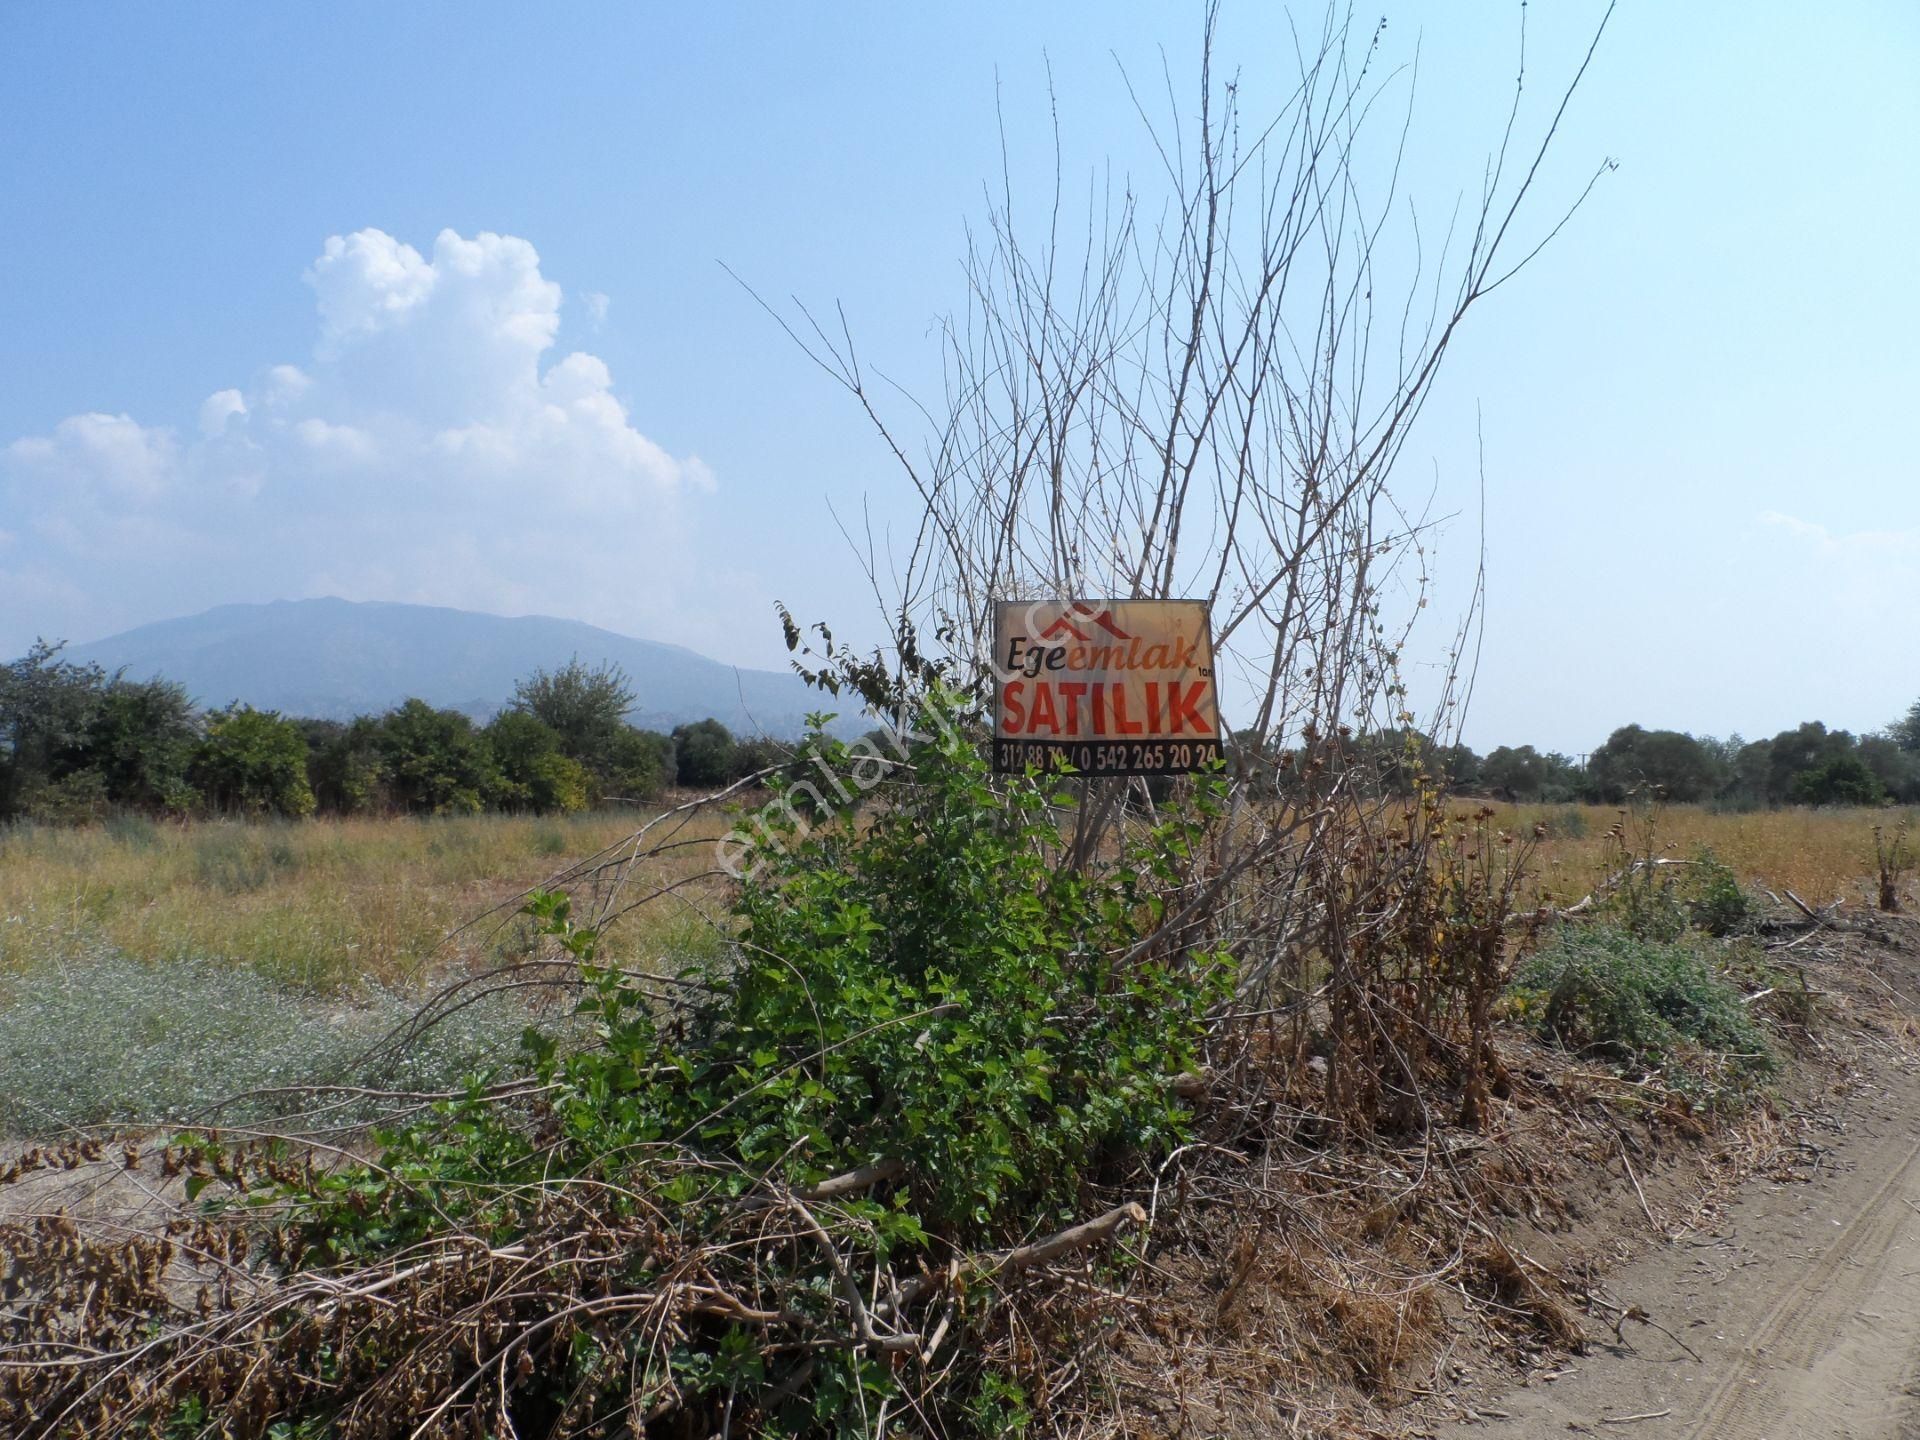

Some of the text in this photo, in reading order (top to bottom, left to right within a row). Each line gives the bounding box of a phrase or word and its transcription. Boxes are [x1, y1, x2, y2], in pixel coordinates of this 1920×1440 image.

[1001, 681, 1213, 736] SATILIK
[1001, 743, 1024, 768] 312
[1027, 745, 1044, 769] 88
[1081, 746, 1091, 770] 0
[1097, 746, 1128, 770] 542
[1132, 745, 1165, 769] 265
[1169, 744, 1191, 768] 20
[1196, 744, 1217, 767] 24
